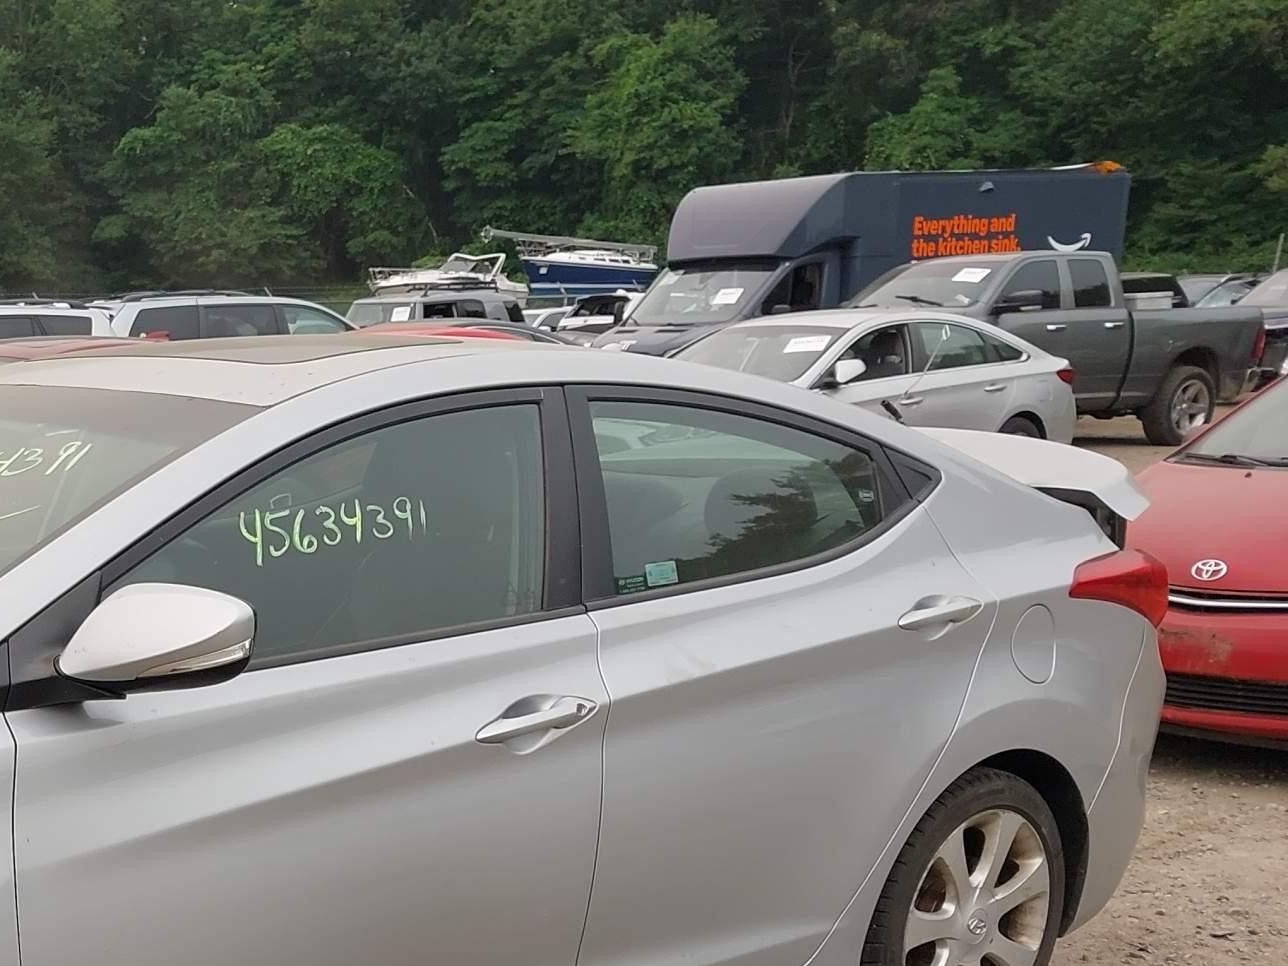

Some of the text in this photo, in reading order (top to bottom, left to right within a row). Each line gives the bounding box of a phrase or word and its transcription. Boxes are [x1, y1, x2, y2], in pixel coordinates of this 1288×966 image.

[913, 213, 1016, 238] Everything and
[912, 234, 1021, 257] the kitchen sink.
[239, 497, 428, 567] 45634391
